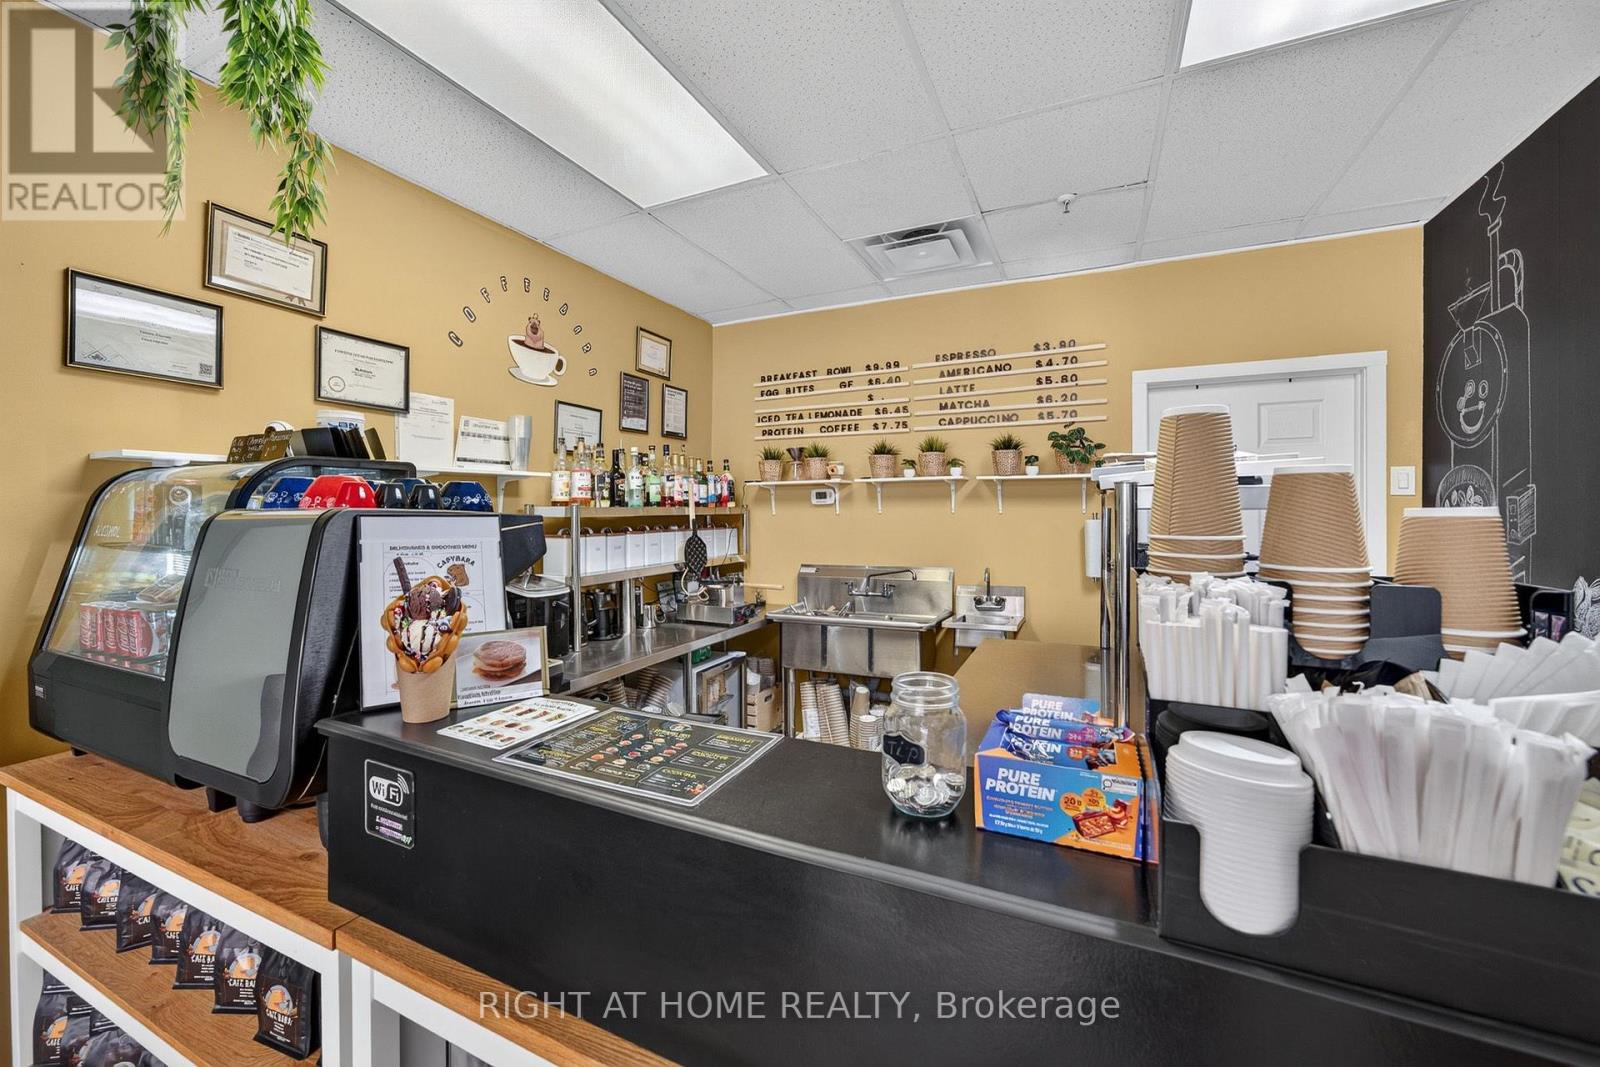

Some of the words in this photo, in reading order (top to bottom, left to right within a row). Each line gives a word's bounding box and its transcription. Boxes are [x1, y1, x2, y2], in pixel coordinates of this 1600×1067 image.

[935, 348, 996, 362] ESPRESSO
[761, 369, 818, 383] BREAKFAST
[826, 366, 852, 377] BOWL
[939, 363, 1012, 379] AMERICANO
[1036, 355, 1078, 369] $4.70
[785, 384, 815, 395] BITES
[939, 383, 976, 395] LATTE
[1036, 373, 1078, 386] $5.80
[939, 399, 990, 411] MATCHA
[1037, 392, 1078, 404] $6.20
[757, 415, 781, 424] ICED
[785, 411, 804, 421] TEA
[808, 408, 863, 420] LEMONADE
[874, 405, 909, 416] $6.45
[938, 412, 1019, 426] CAPPUCCINO
[1038, 409, 1078, 421] $5.70
[761, 427, 804, 437] PROTEIN
[819, 423, 860, 434] COFFEE
[872, 420, 909, 431] $7.75
[1031, 699, 1064, 710] PURE
[1015, 714, 1051, 726] PURE
[1023, 707, 1073, 721] PROTEIN
[998, 768, 1041, 786] PURE
[985, 778, 1056, 802] PROTEIN
